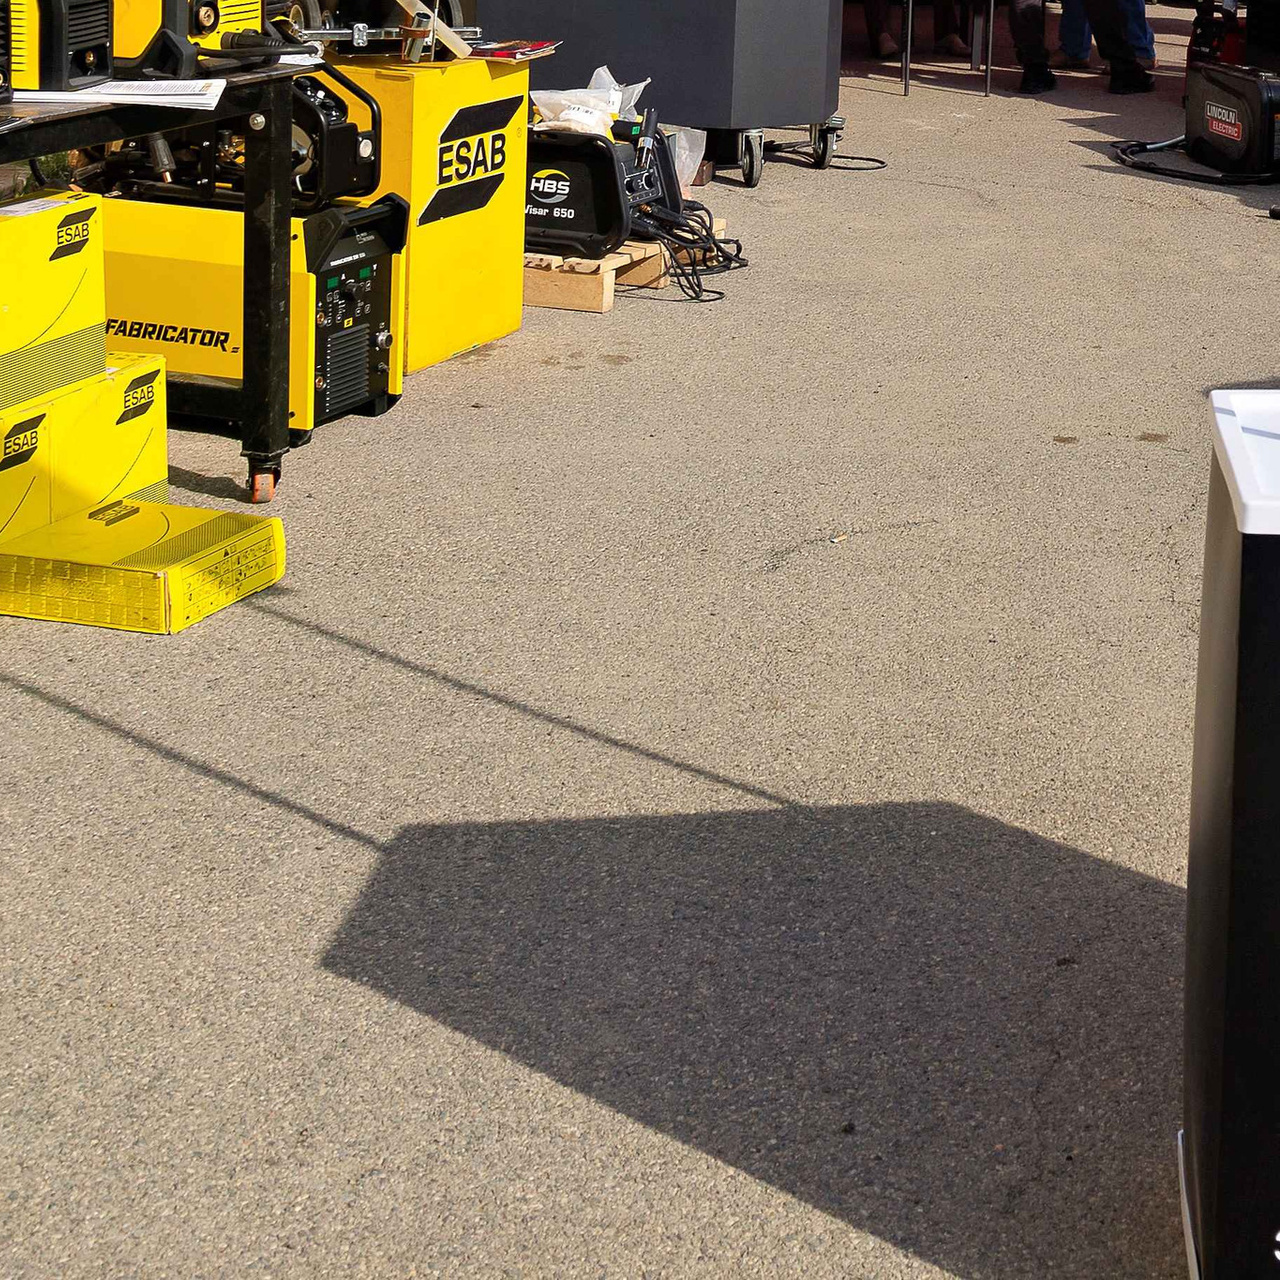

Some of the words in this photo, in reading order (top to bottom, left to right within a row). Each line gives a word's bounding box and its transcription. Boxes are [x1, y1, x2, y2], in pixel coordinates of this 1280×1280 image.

[1206, 104, 1236, 124] LINCOLN
[1212, 122, 1239, 137] ELECTRIC
[437, 131, 507, 186] ESAB
[530, 178, 571, 195] HBS
[553, 207, 575, 219] 650
[57, 223, 90, 246] ESAB
[105, 318, 231, 354] FABRICATOR
[124, 385, 155, 409] ESAB
[3, 431, 39, 457] ESAB
